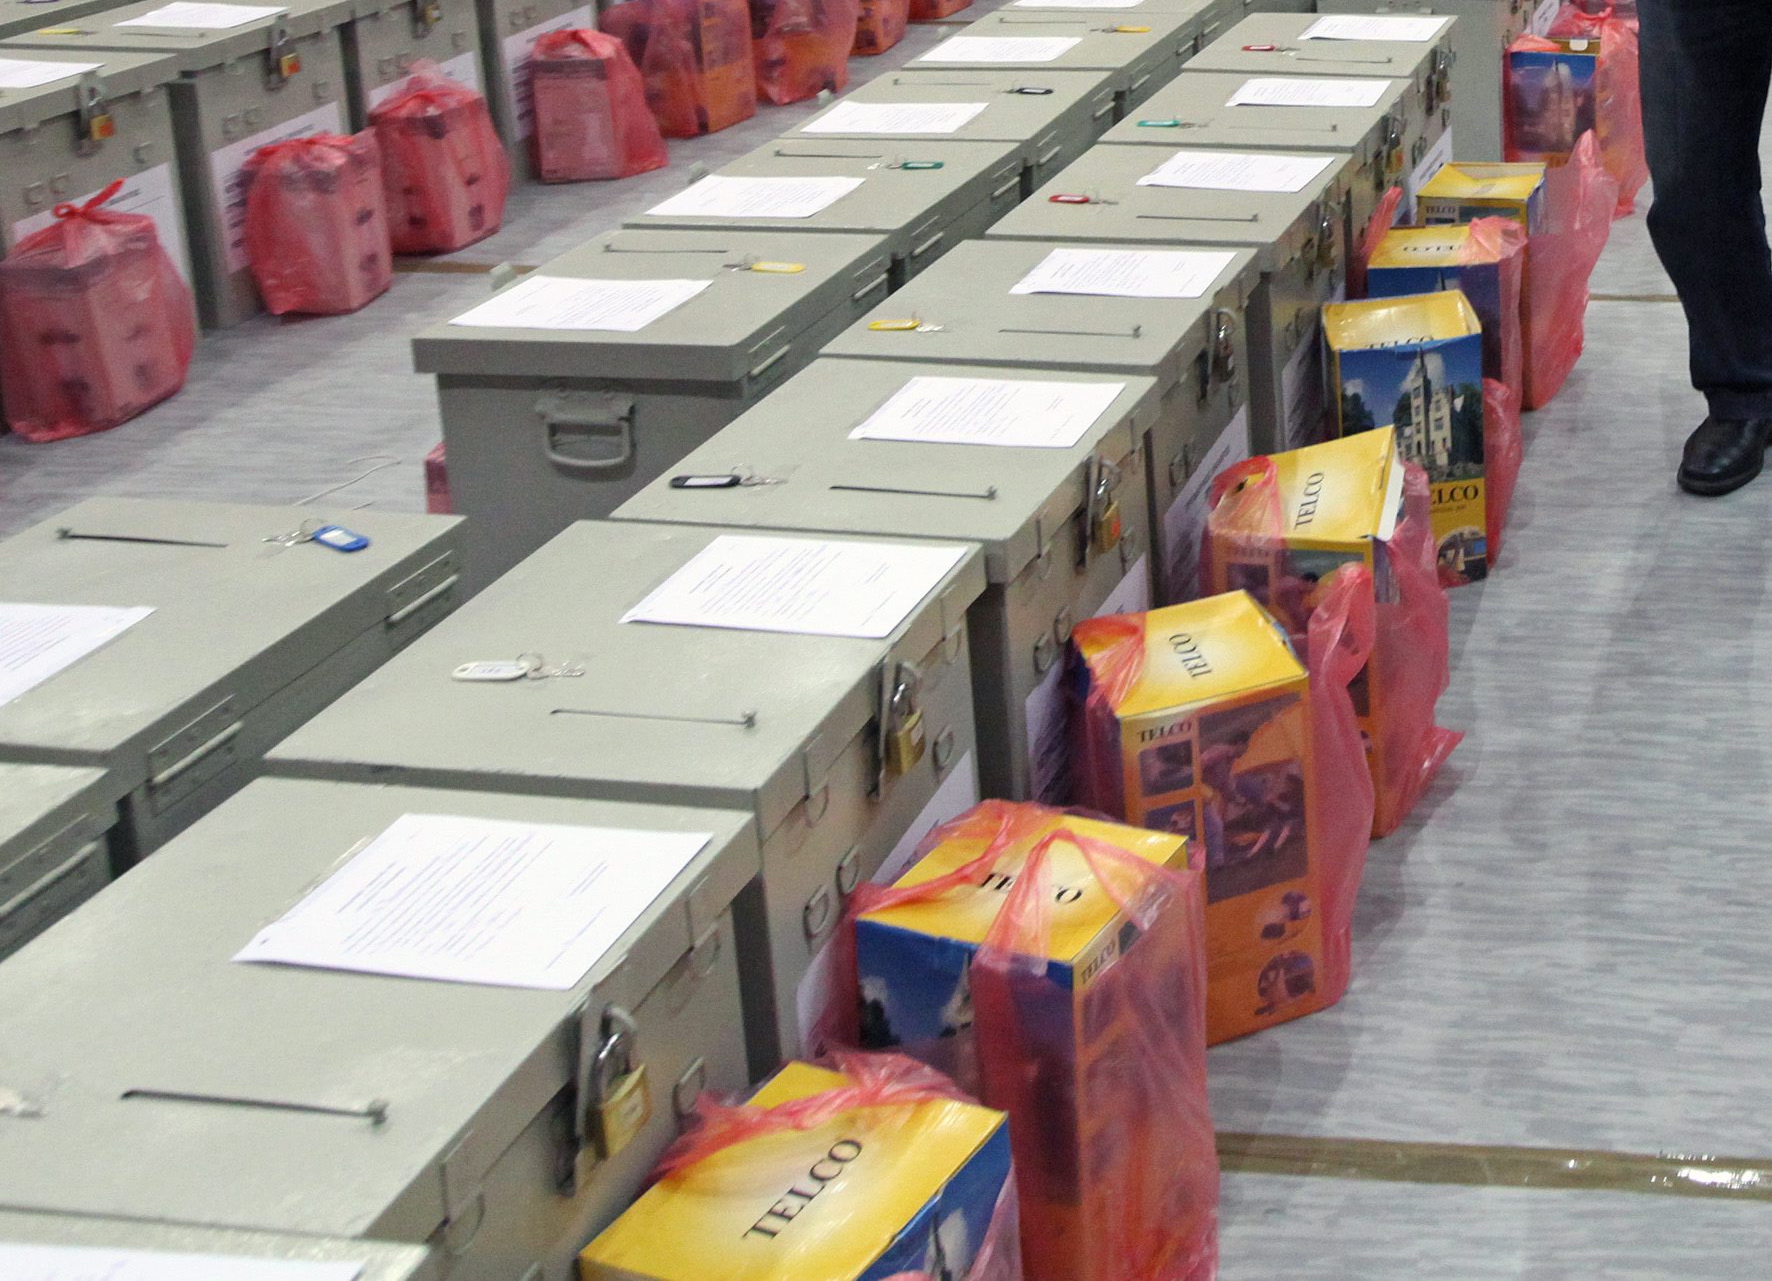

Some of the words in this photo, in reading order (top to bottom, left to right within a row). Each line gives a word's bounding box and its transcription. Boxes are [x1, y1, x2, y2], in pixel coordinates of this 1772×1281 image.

[1293, 471, 1325, 530] TELCO
[1168, 632, 1214, 679] TELCO
[1137, 720, 1193, 744] TELCO
[1080, 939, 1117, 984] TELCO
[743, 1138, 864, 1241] TELCO
